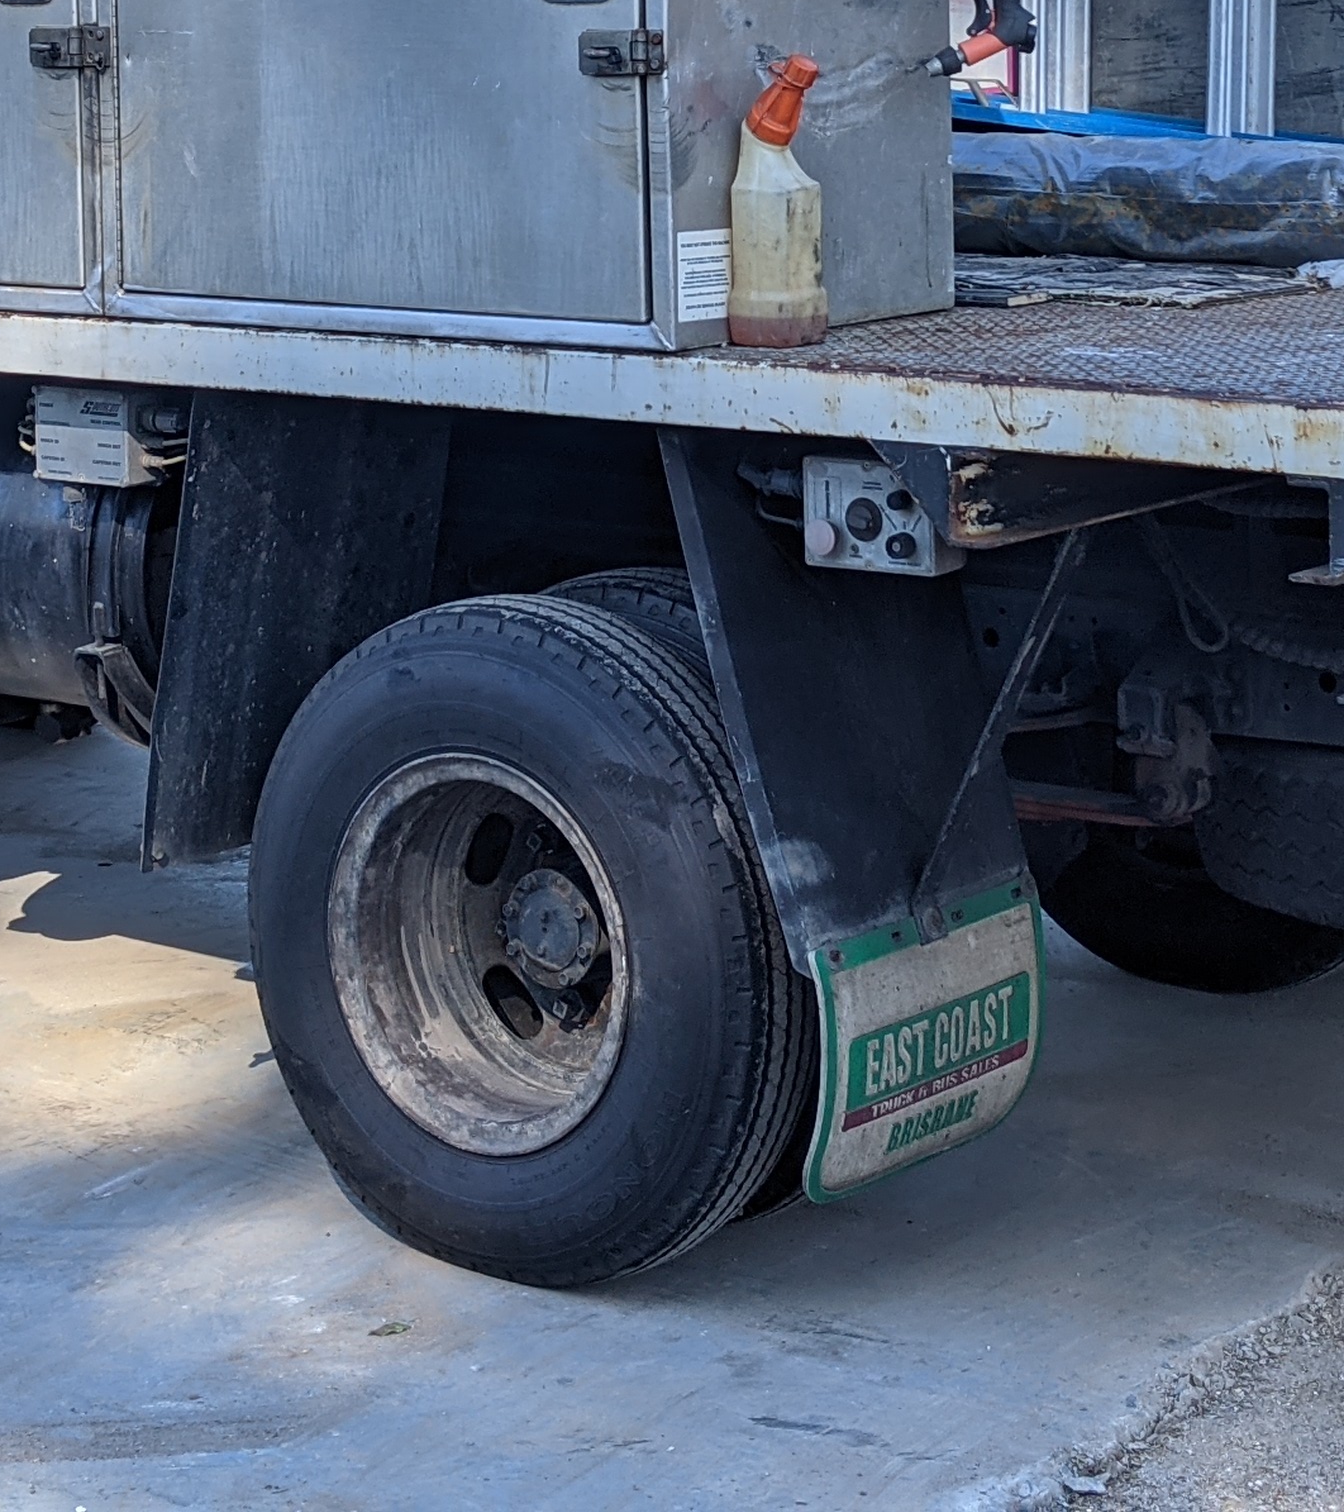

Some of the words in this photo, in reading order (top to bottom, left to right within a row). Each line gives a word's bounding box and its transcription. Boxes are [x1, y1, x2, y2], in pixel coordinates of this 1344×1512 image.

[865, 1019, 930, 1096] EAST
[934, 985, 1014, 1069] COAST
[871, 1089, 916, 1118] TRUCK
[932, 1074, 958, 1093] BUS
[961, 1054, 1001, 1080] SALES
[885, 1088, 979, 1155] BRISBANE
